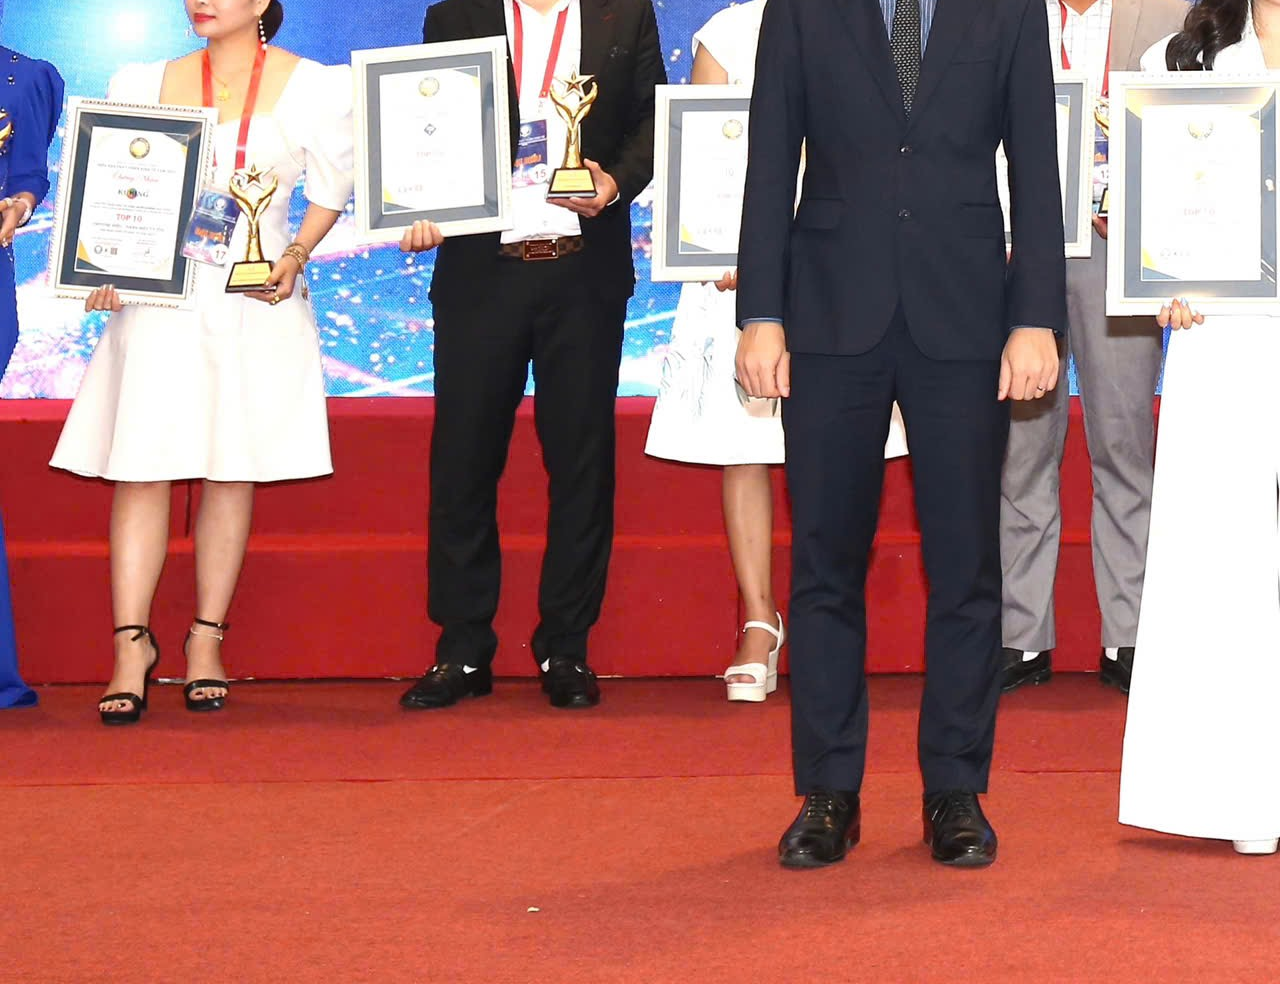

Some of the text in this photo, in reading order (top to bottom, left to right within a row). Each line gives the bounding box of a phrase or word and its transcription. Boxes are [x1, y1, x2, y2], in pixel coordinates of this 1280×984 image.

[535, 170, 547, 179] 15
[116, 213, 132, 221] TOP
[215, 249, 226, 260] 17
